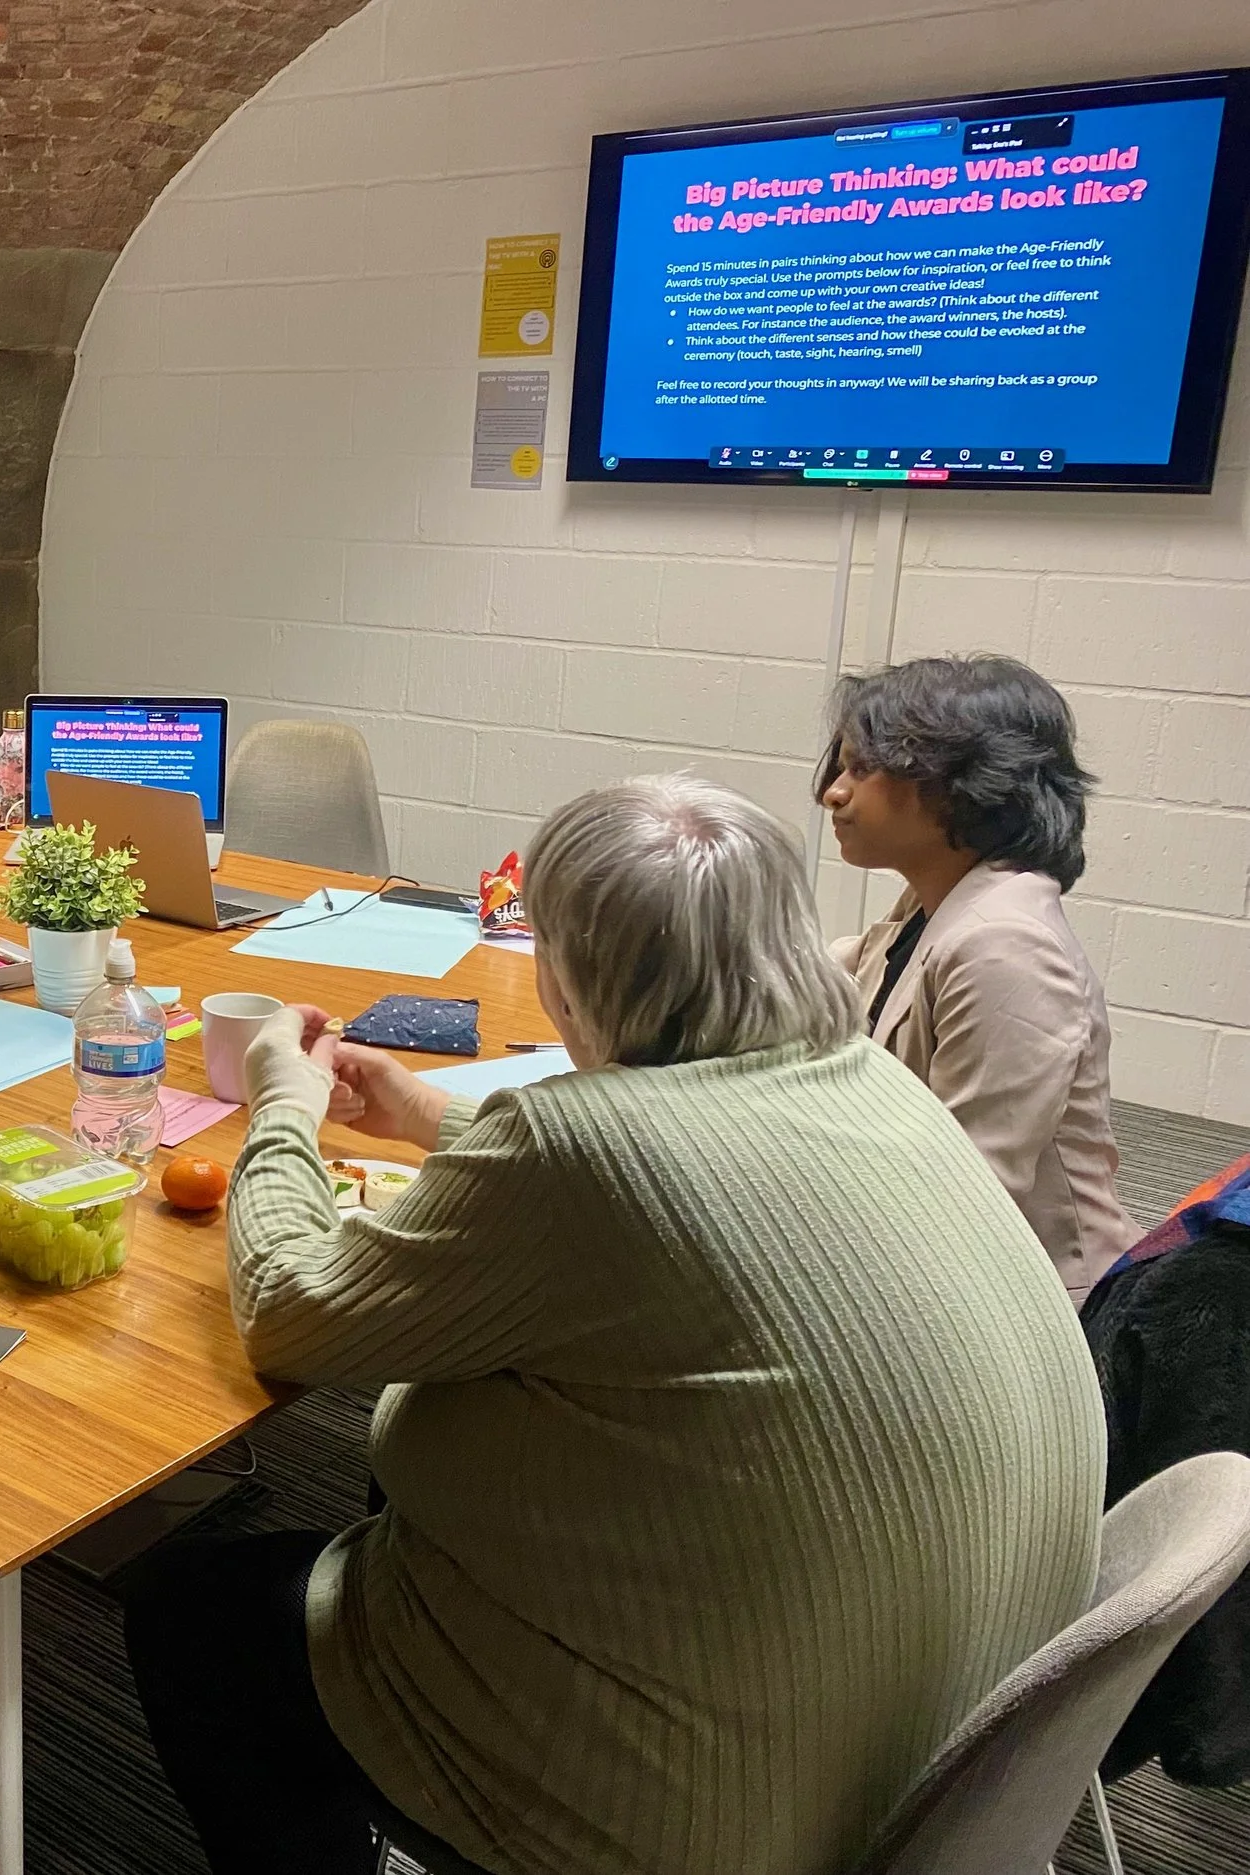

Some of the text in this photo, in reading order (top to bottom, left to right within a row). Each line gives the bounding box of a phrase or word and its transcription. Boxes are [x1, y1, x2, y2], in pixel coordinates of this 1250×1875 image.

[686, 146, 1138, 206] Big Picture Thinking: What could
[673, 179, 1147, 233] the Age-Friendly Awards look like?
[666, 238, 1104, 275] Spend 15 minutes in pairs thinking about how we can make the Age-Friendly
[664, 254, 1112, 288] Awards truly special. Use the prompts below for inspiration, or feel free to think
[663, 278, 985, 303] outside the box and come up with your own creative ideas!
[688, 290, 1099, 316] How do we want people to feel at the awards? (Think about the different
[686, 306, 1067, 331] attendees. For instance the audience, the award winners, the hosts).
[685, 323, 1086, 345] Think about the different senses and how these could be evoked at the
[684, 344, 922, 362] ceremony (touch, taste, sight, hearing, smell)
[656, 374, 1098, 391] Feel free to record your thoughts in anyway! We will be sharing back as a group
[654, 394, 766, 404] after the allotted time.
[56, 721, 71, 731] Big
[72, 722, 104, 730] Picture
[148, 723, 173, 731] What
[174, 723, 200, 732] could
[69, 731, 124, 741] Age-Friendly
[181, 733, 203, 741] like?
[88, 1061, 113, 1070] LIVES
